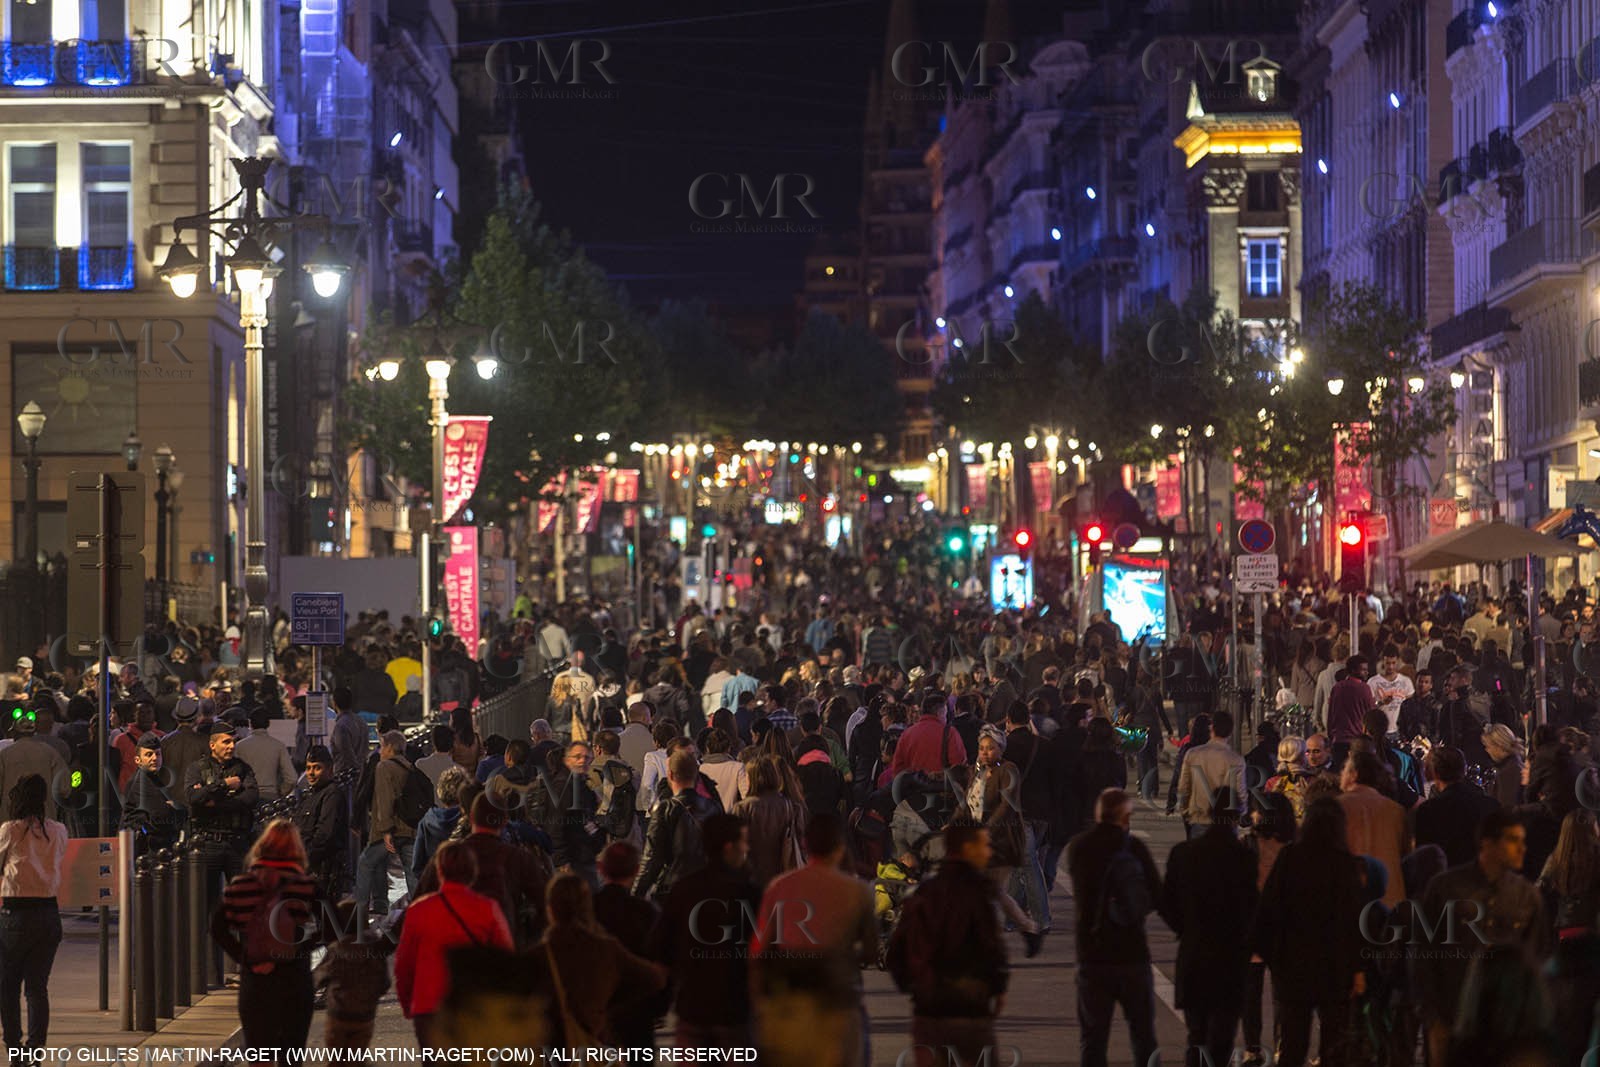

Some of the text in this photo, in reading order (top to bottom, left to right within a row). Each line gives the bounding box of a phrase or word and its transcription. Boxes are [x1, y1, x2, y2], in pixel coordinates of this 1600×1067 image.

[459, 566, 473, 632] CAPITALE
[320, 606, 337, 615] Port
[295, 620, 308, 631] 83
